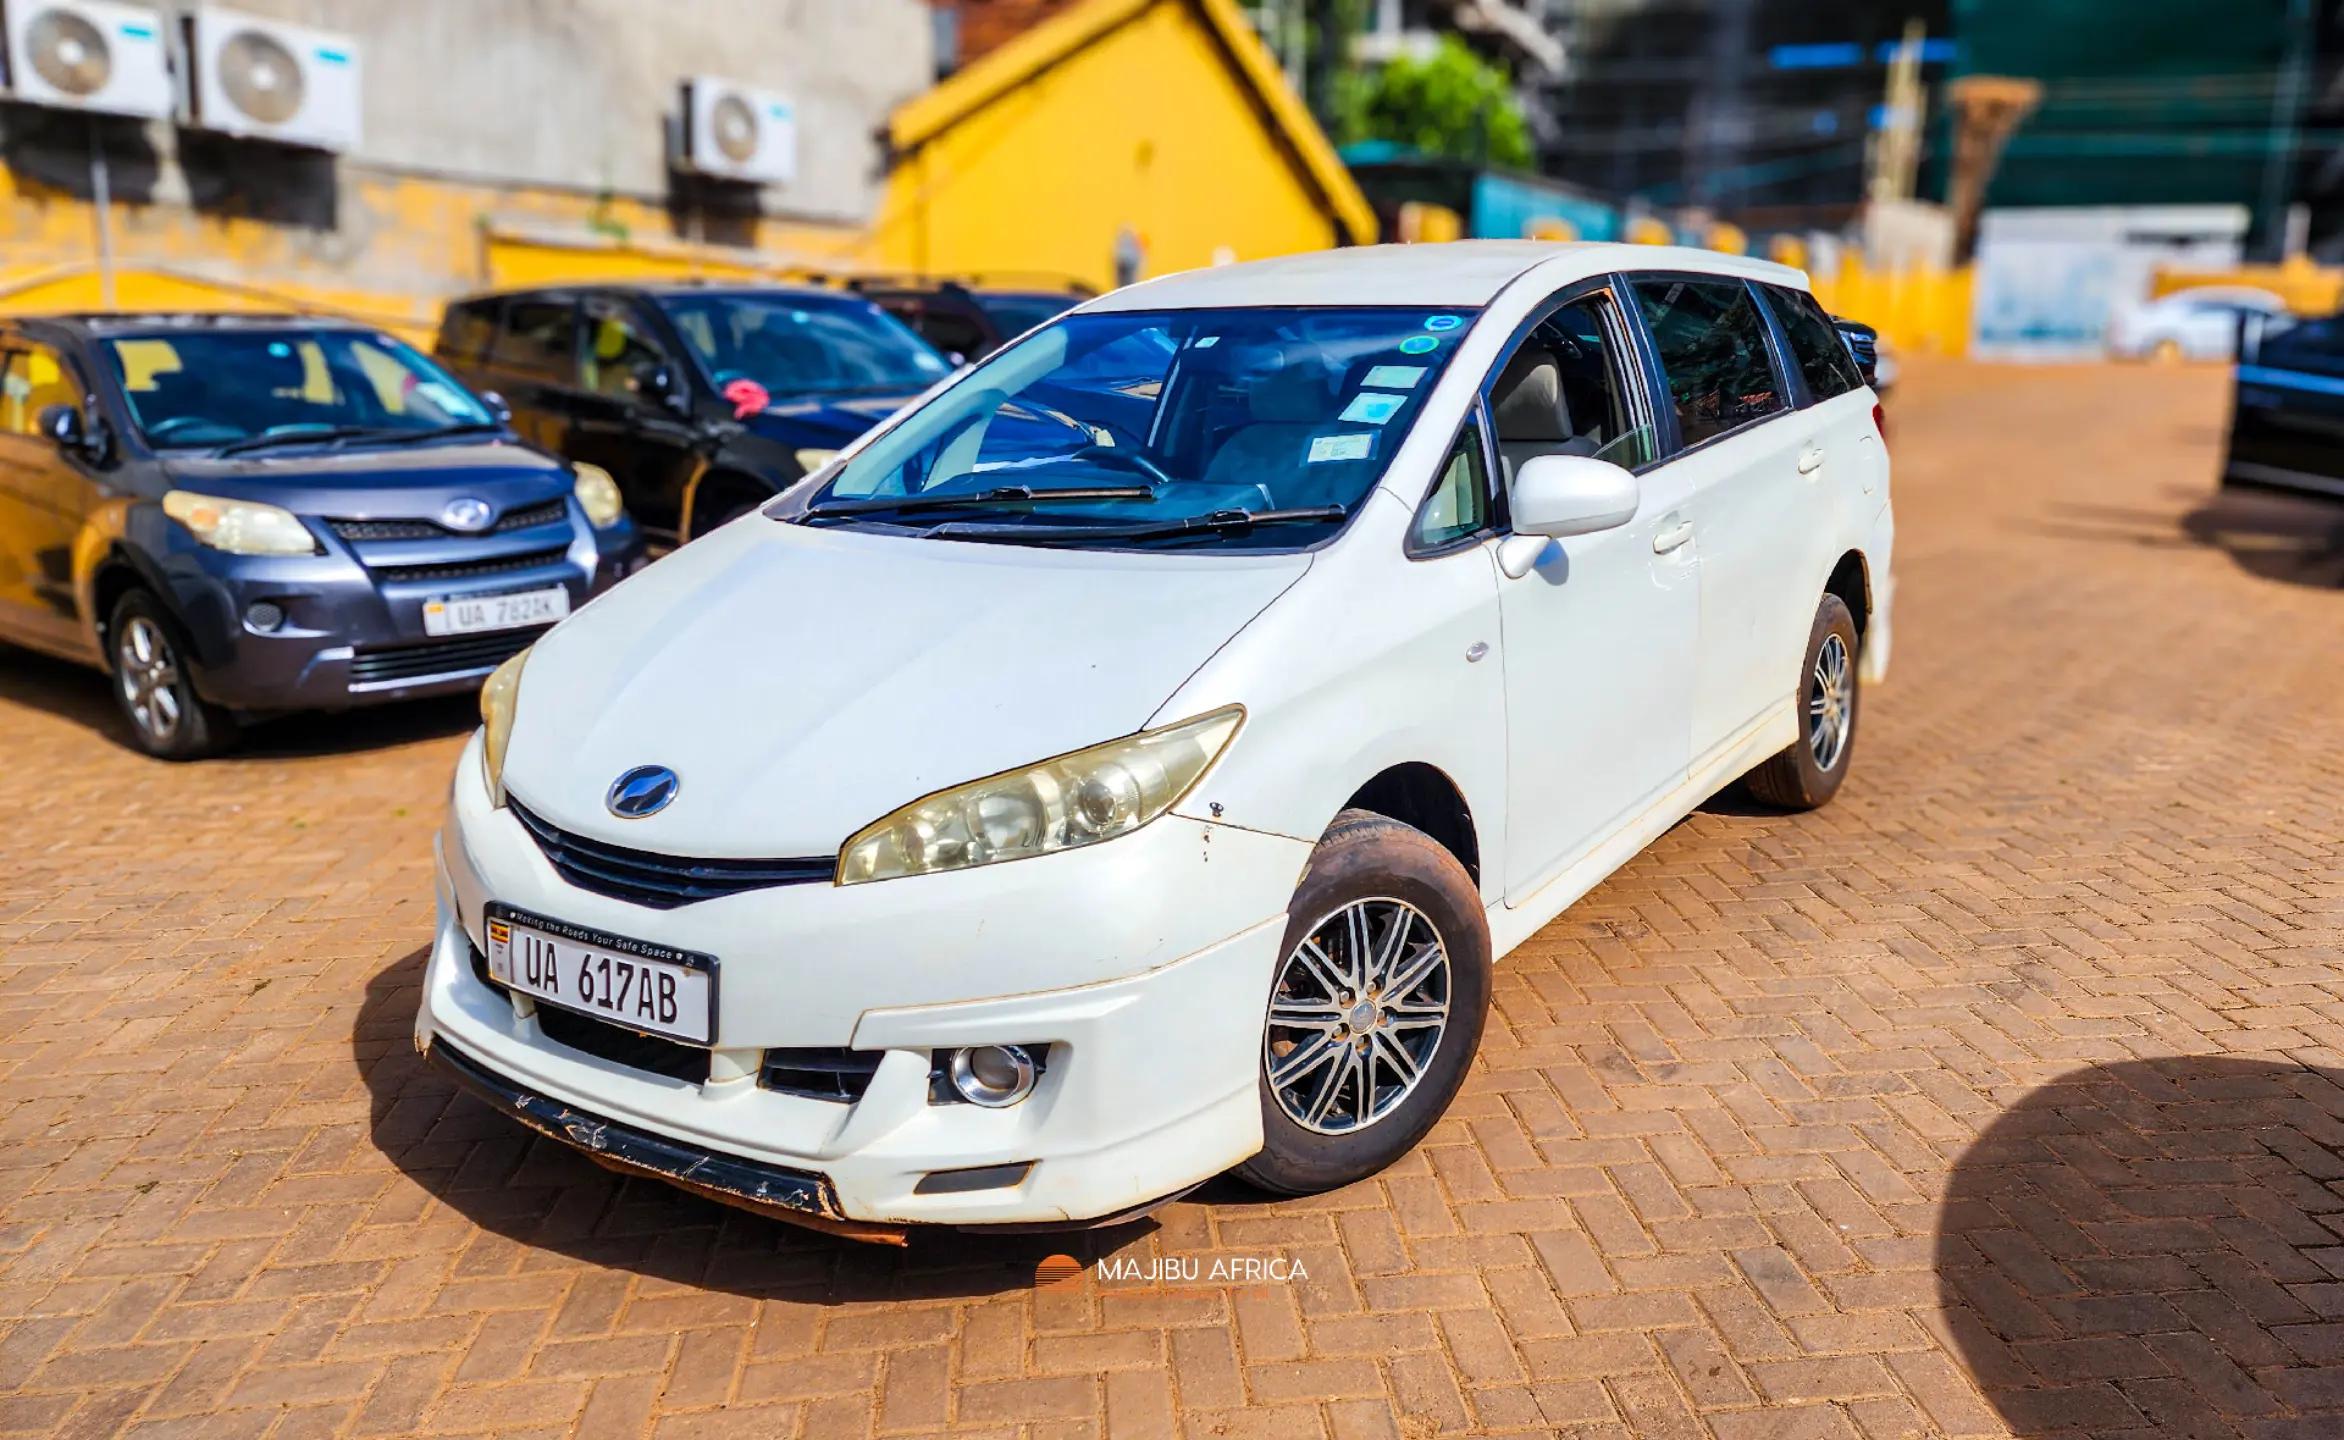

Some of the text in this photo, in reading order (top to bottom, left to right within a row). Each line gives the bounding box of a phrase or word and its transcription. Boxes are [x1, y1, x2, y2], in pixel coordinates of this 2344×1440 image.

[458, 603, 486, 626] UA
[546, 922, 560, 932] the
[562, 926, 588, 940] Roads
[592, 933, 614, 946] Your
[616, 939, 638, 952] Safe
[640, 944, 673, 959] Space
[526, 936, 677, 1024] UA 617AB
